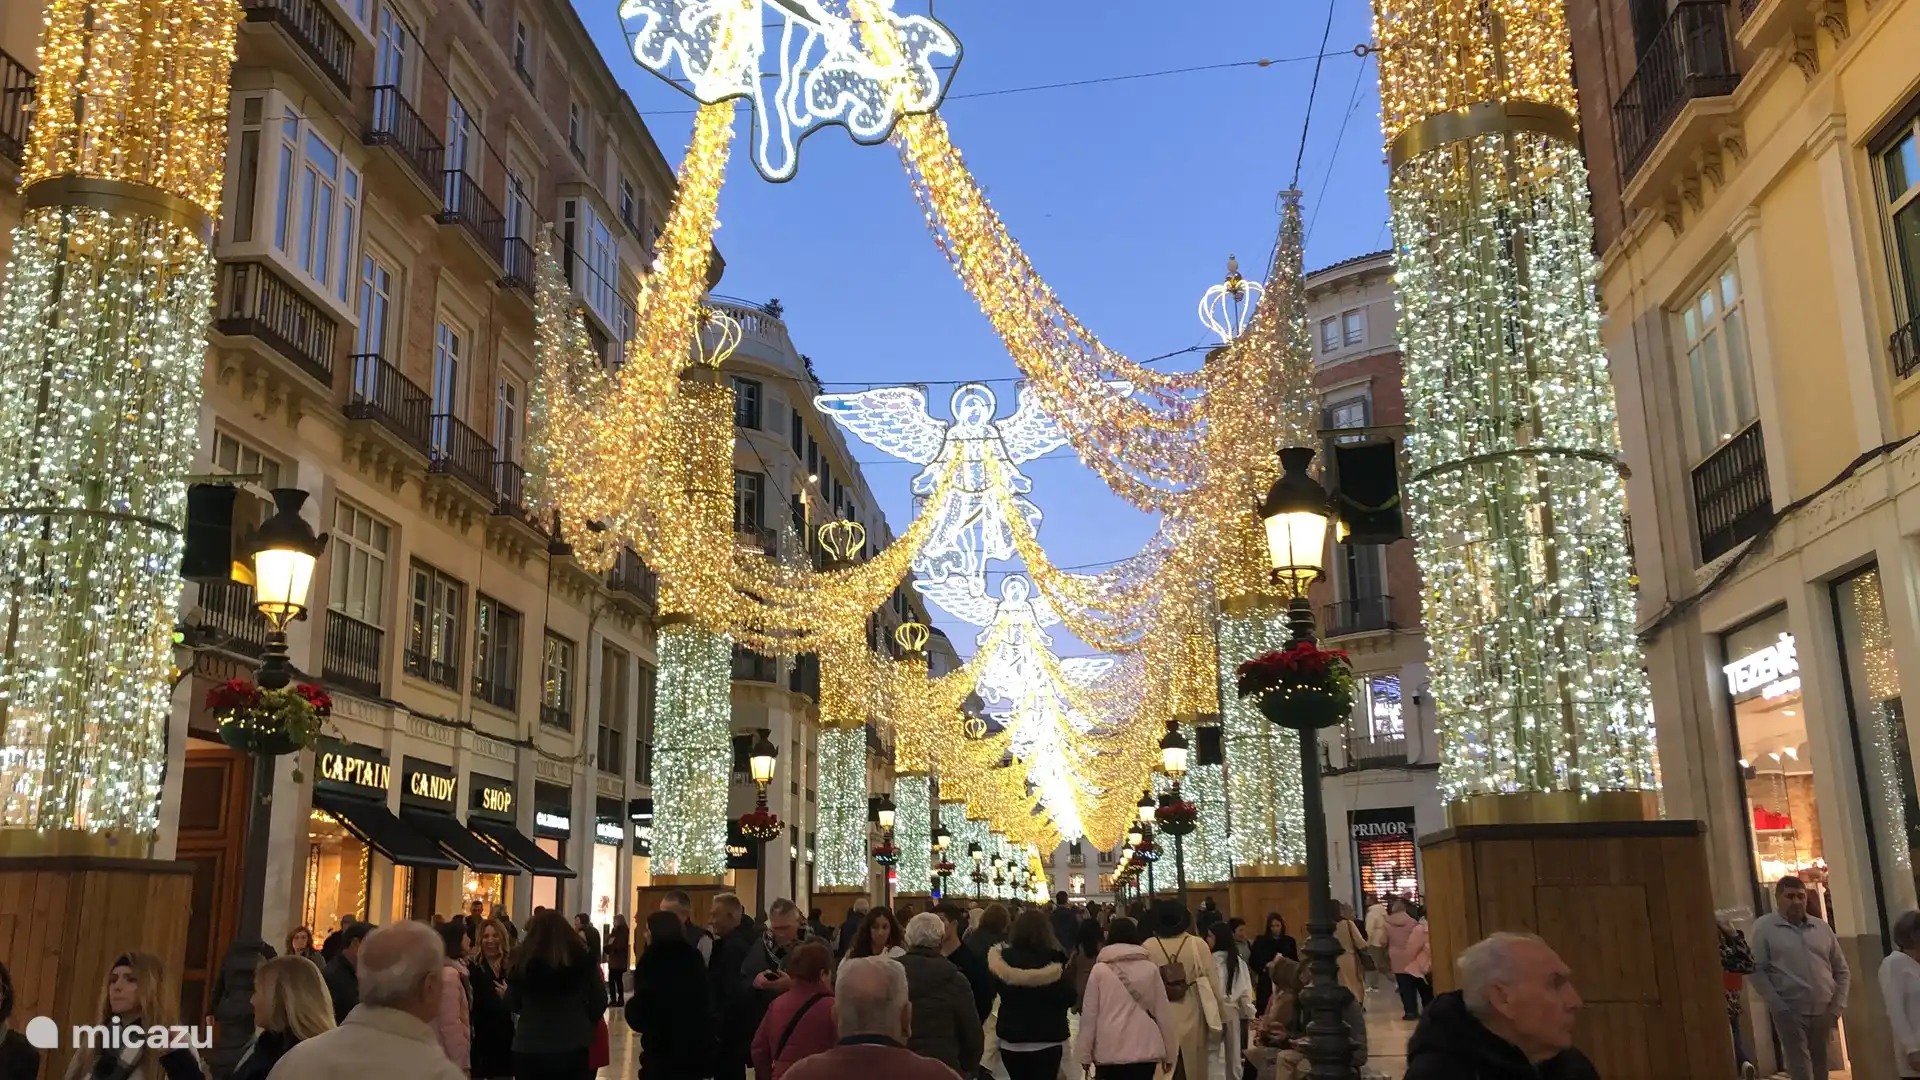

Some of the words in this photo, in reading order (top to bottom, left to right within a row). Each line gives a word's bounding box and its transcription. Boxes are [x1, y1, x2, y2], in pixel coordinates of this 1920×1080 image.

[321, 752, 391, 790] CAPTAIN
[410, 771, 456, 801] CANDY
[482, 787, 512, 813] SHOP
[1351, 821, 1408, 838] PRIMOR
